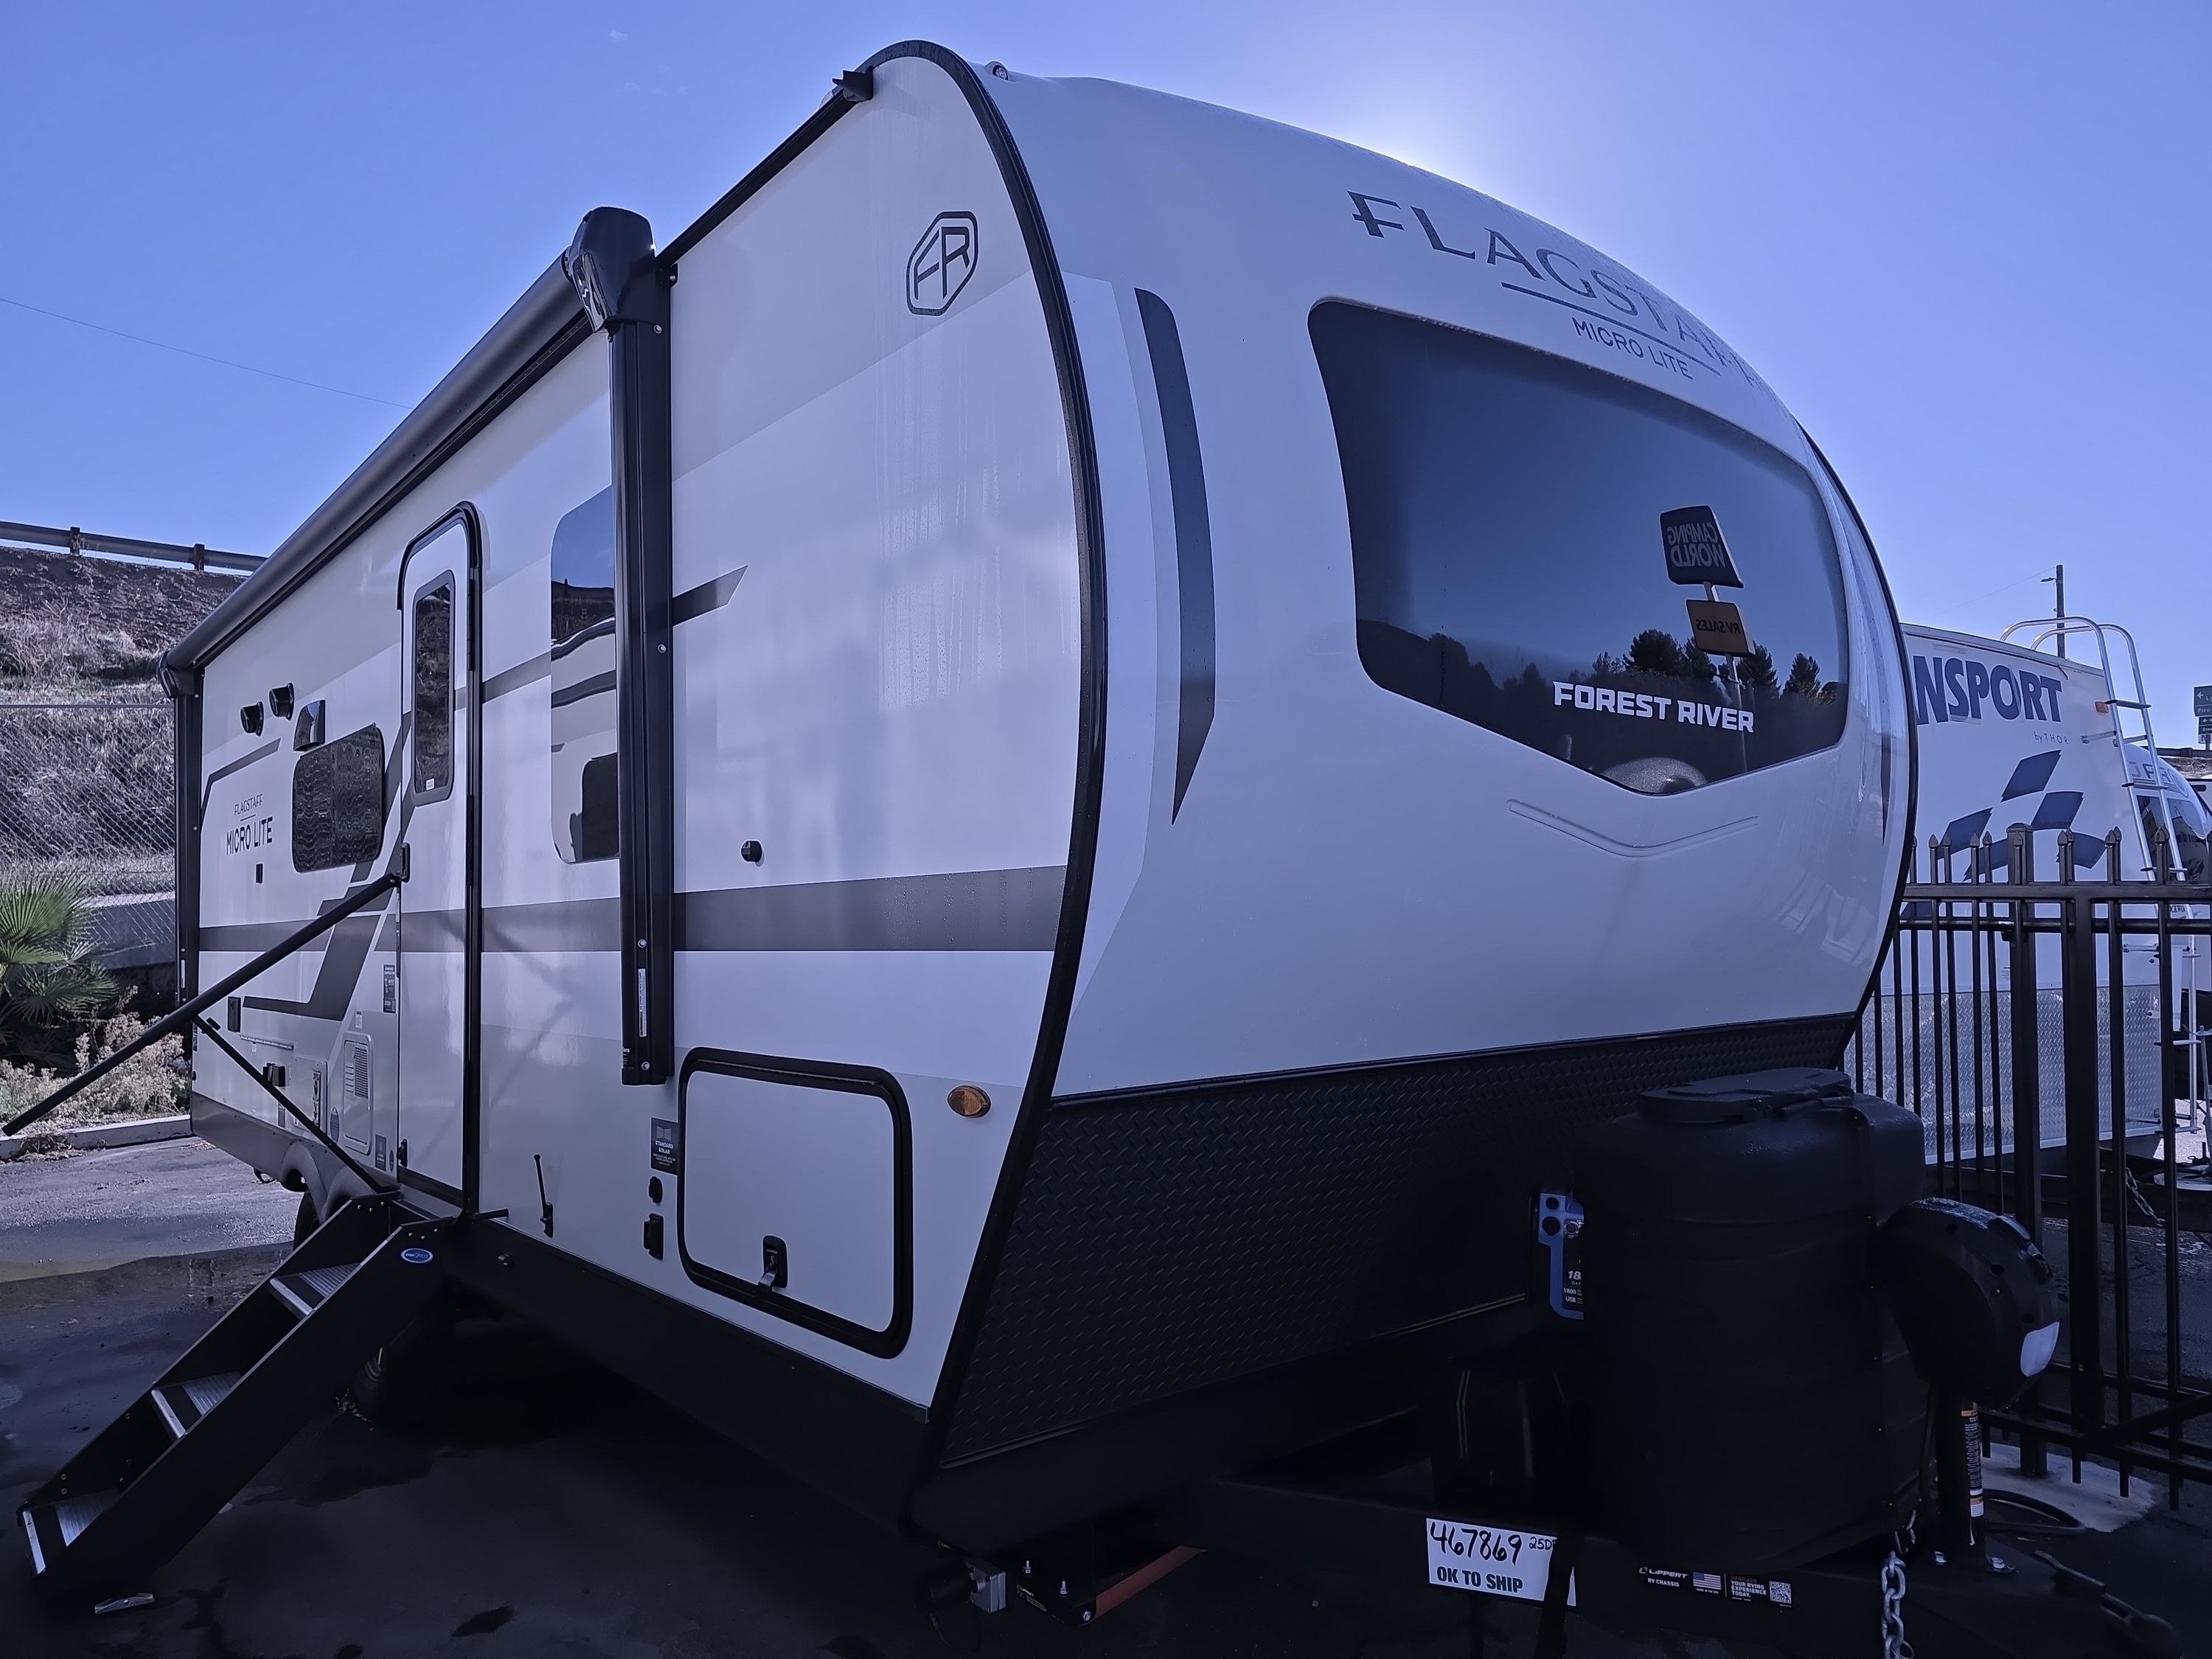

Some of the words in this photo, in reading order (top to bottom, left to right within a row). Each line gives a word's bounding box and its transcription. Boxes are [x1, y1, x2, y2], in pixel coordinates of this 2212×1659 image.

[1571, 316, 1644, 359] MICRO
[1647, 345, 1694, 380] LITE
[1554, 681, 1672, 720] FOREST
[1677, 700, 1755, 733] RIVER
[2044, 733, 2070, 745] THOR
[234, 793, 262, 815] FLAGSTAFF
[226, 824, 251, 855] MICRO
[254, 816, 273, 847] LITE
[1430, 1521, 1522, 1566] 467869
[1437, 1566, 1459, 1584] OK
[1462, 1570, 1481, 1587] TO
[1486, 1573, 1523, 1593] SHIP
[1731, 1585, 1767, 1596] EXPERIENCE
